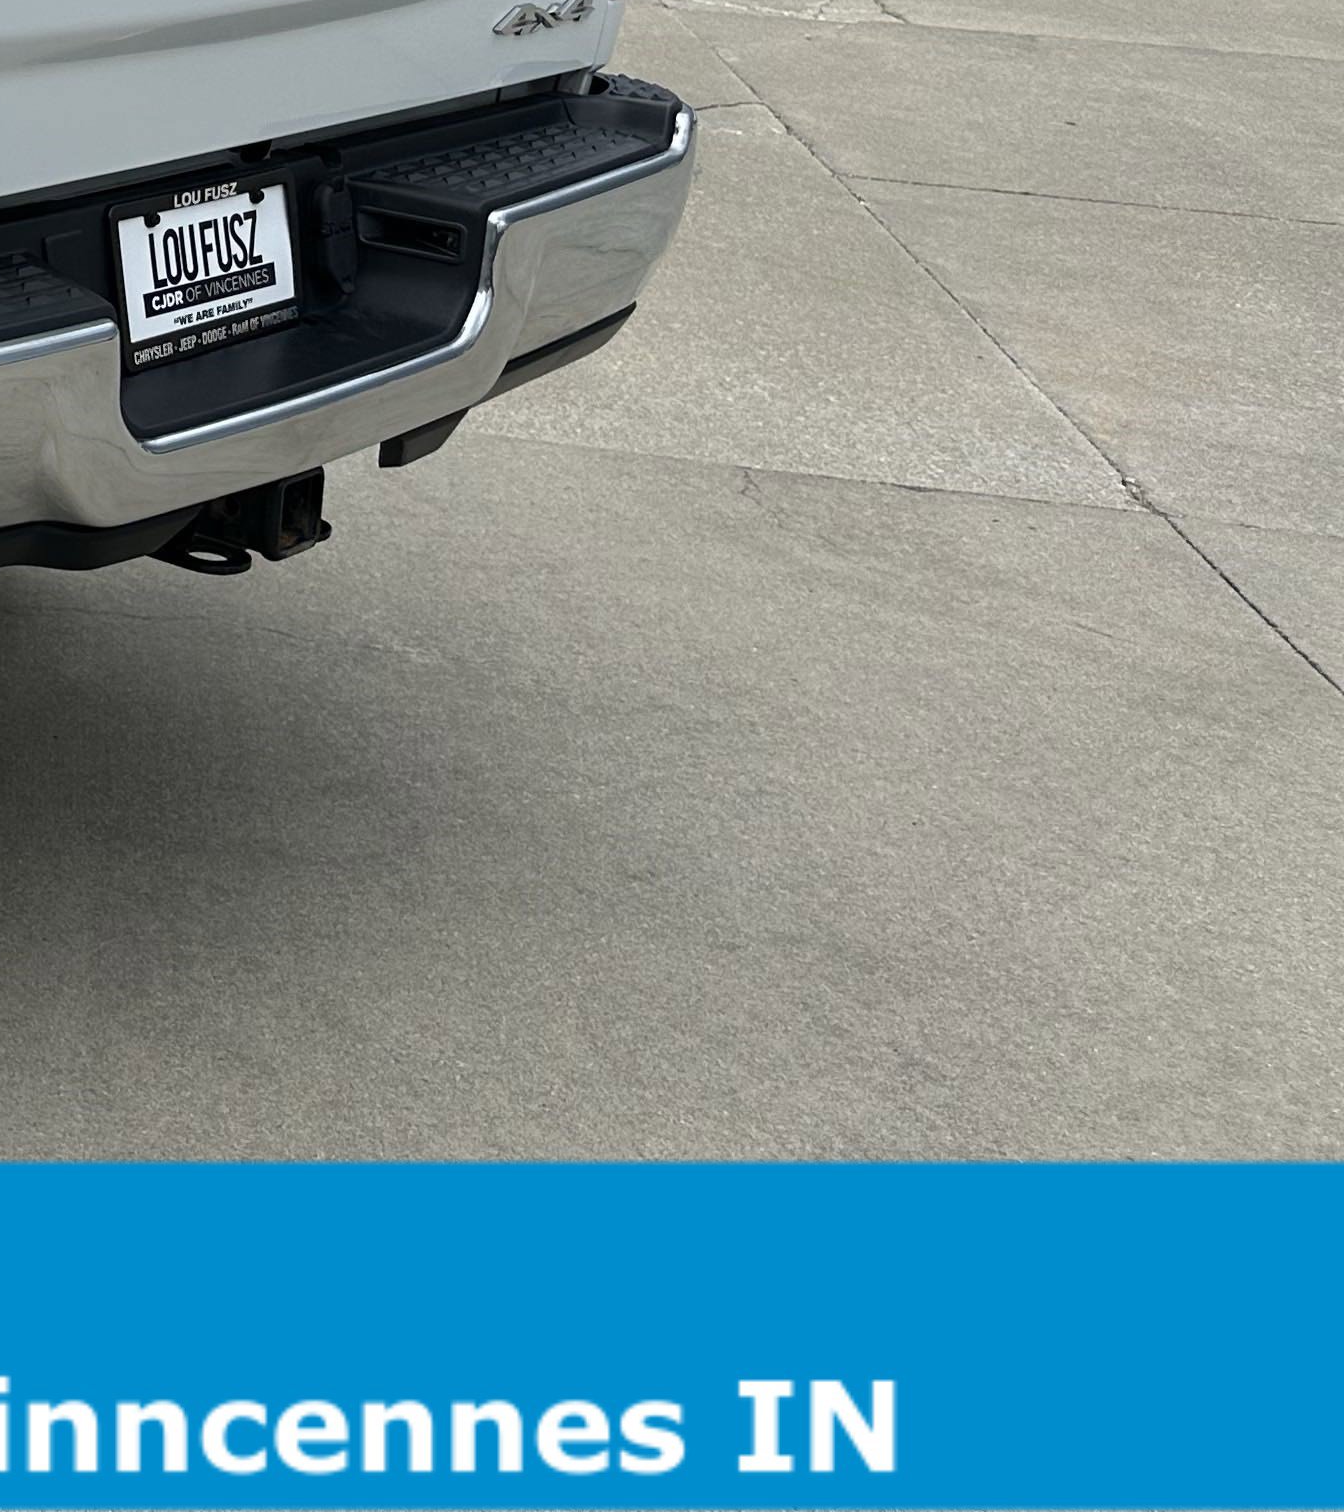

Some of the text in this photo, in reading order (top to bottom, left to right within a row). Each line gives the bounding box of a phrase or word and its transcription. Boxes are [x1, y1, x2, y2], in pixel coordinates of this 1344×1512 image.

[173, 182, 238, 208] LOU FUSZ
[151, 268, 270, 311] CJDR OF VINCENNES
[196, 308, 215, 321] ARE
[134, 342, 174, 365] CHRYSLER
[178, 334, 197, 352] JEEP
[201, 325, 227, 345] DODGE
[249, 317, 260, 330] OF
